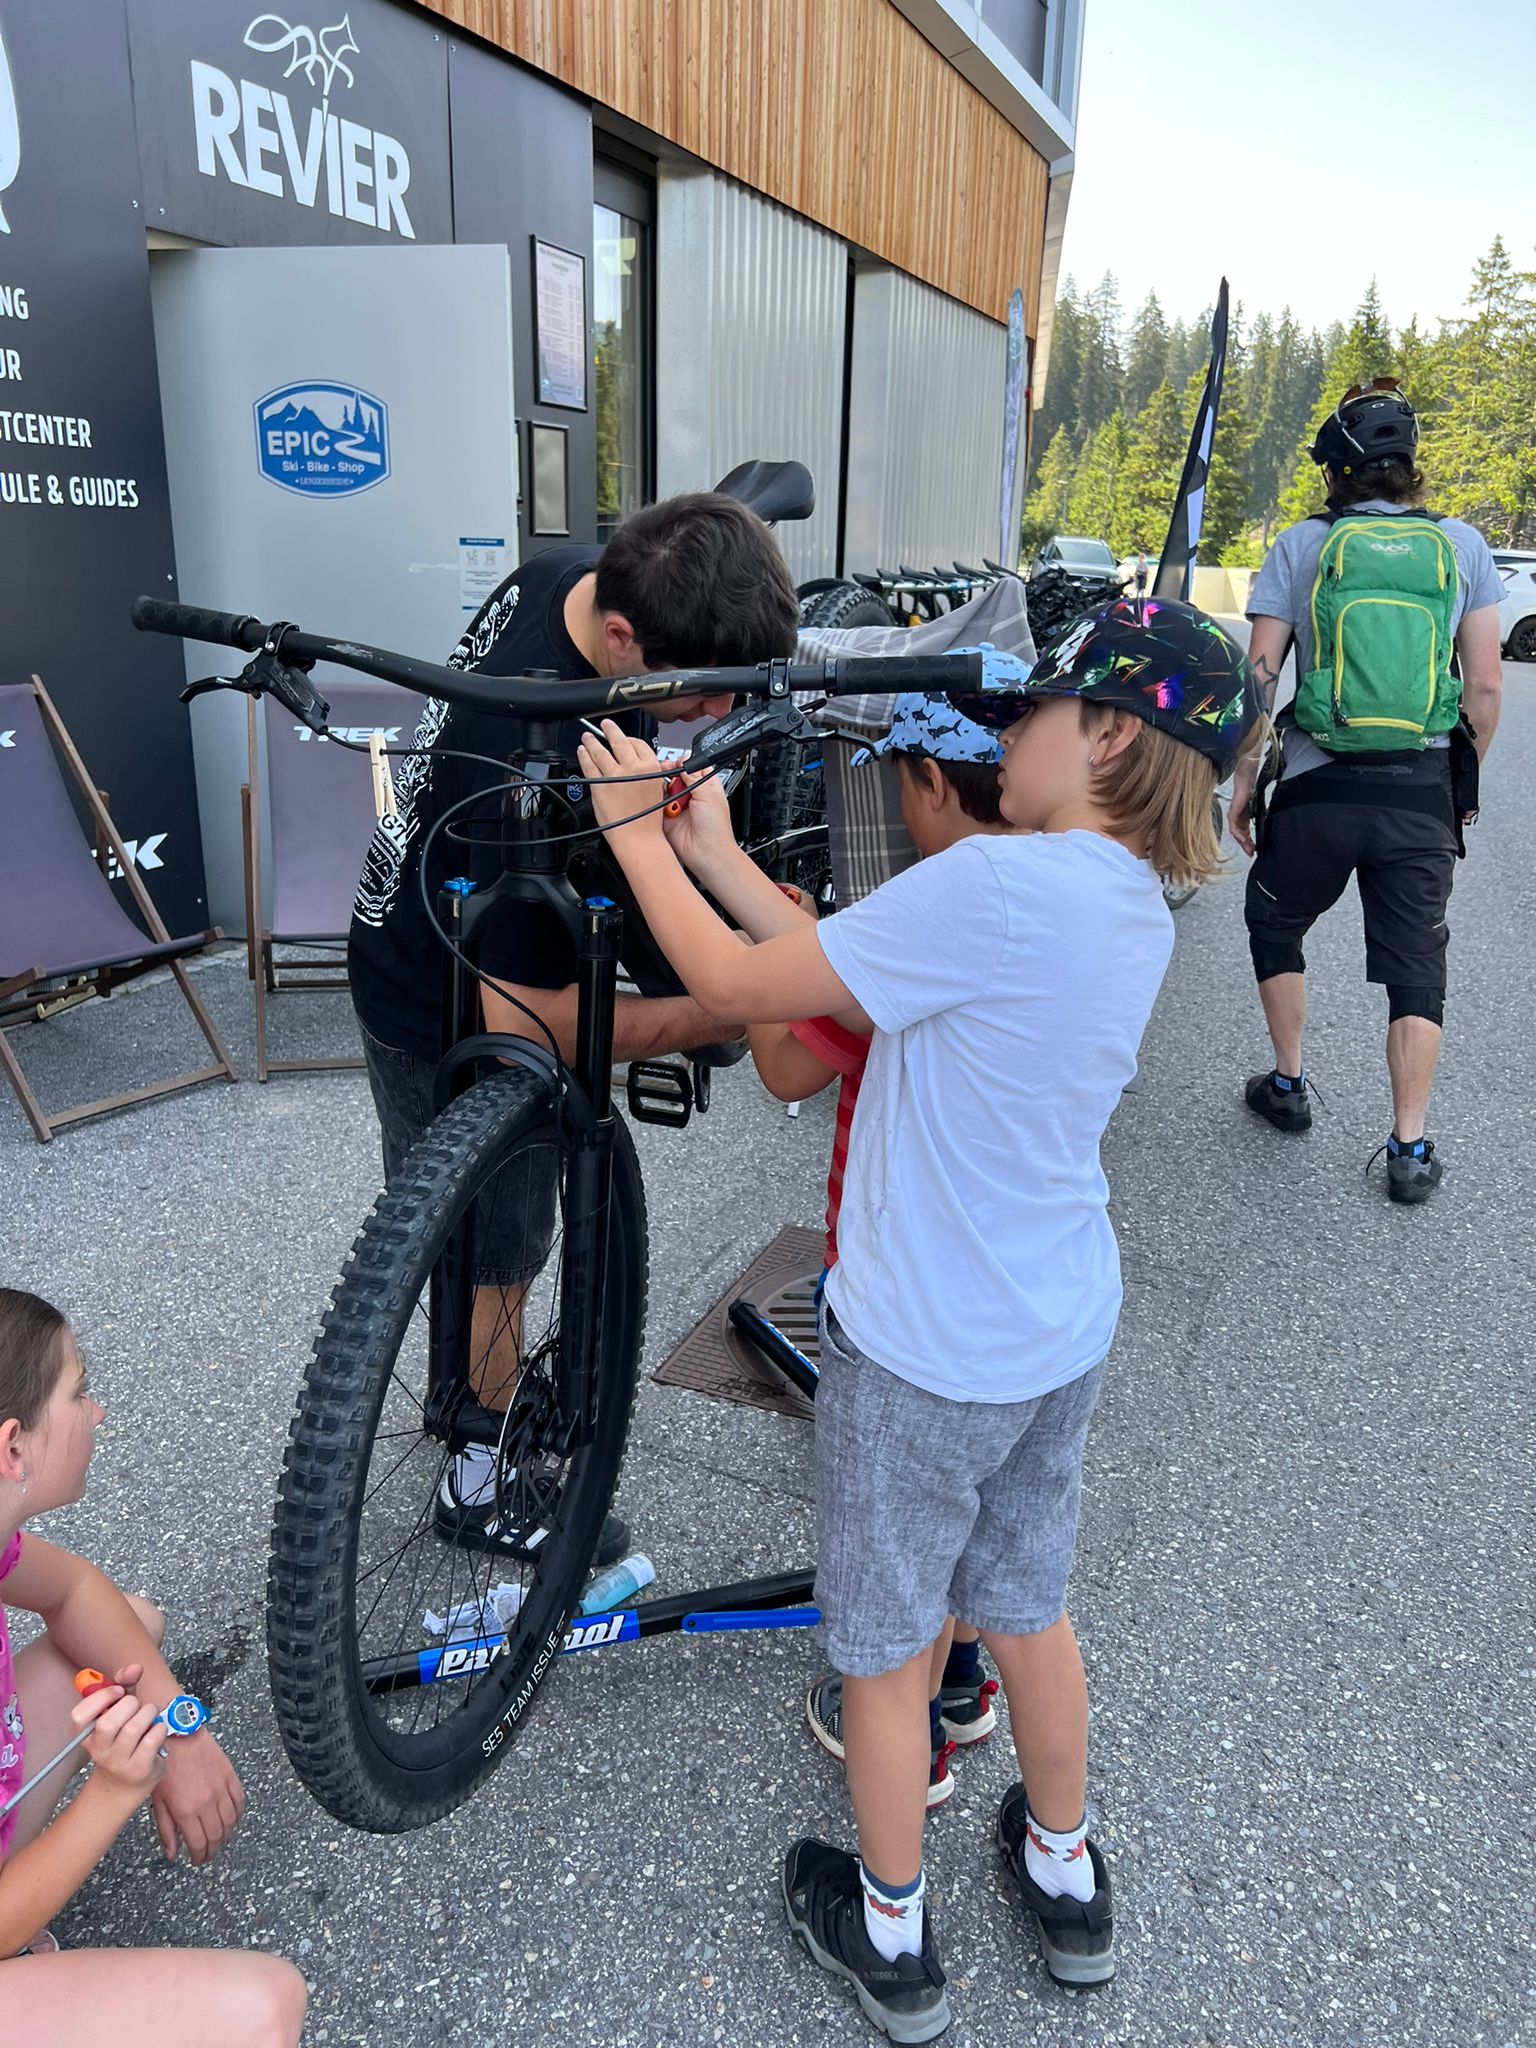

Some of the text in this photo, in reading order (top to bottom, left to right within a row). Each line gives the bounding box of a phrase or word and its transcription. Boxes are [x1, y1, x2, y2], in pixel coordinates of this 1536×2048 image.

[190, 60, 415, 240] REVIER
[267, 430, 330, 457] EPIC
[282, 460, 299, 472] Ski
[306, 461, 330, 472] Bike
[338, 461, 365, 475] Shop
[47, 475, 64, 505] &
[69, 476, 139, 508] GUIDES
[294, 726, 402, 742] TREK
[481, 1631, 560, 1758] SE5 TEAM ISSUE
